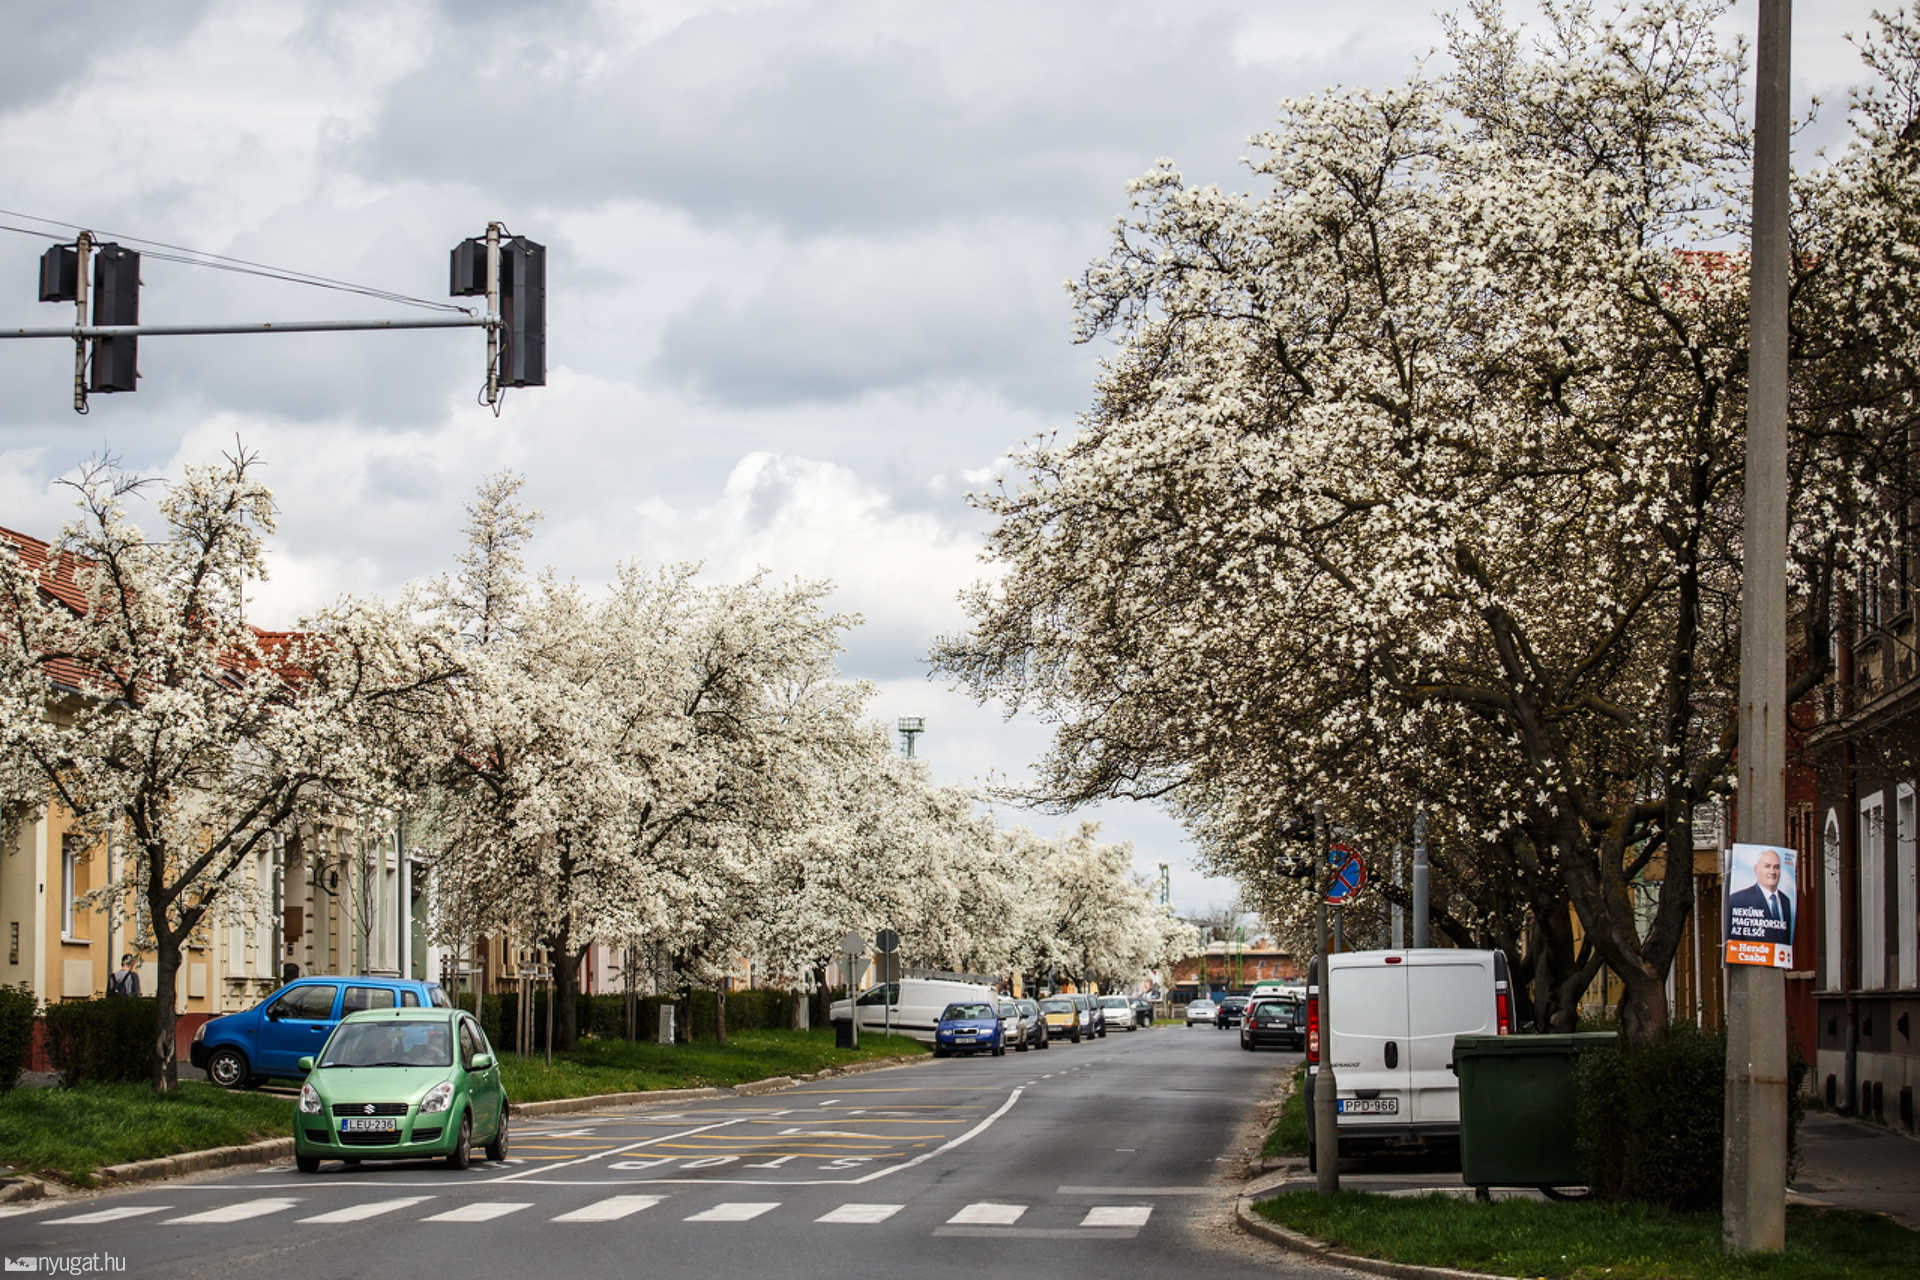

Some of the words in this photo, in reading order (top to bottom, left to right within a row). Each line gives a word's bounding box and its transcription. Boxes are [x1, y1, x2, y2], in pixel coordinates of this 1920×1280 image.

[1732, 906, 1765, 918] NEKÜNK
[1731, 927, 1742, 936] AZ
[1739, 943, 1770, 954] Hende
[1738, 952, 1767, 962] Csaba
[349, 1120, 394, 1129] LEU-236
